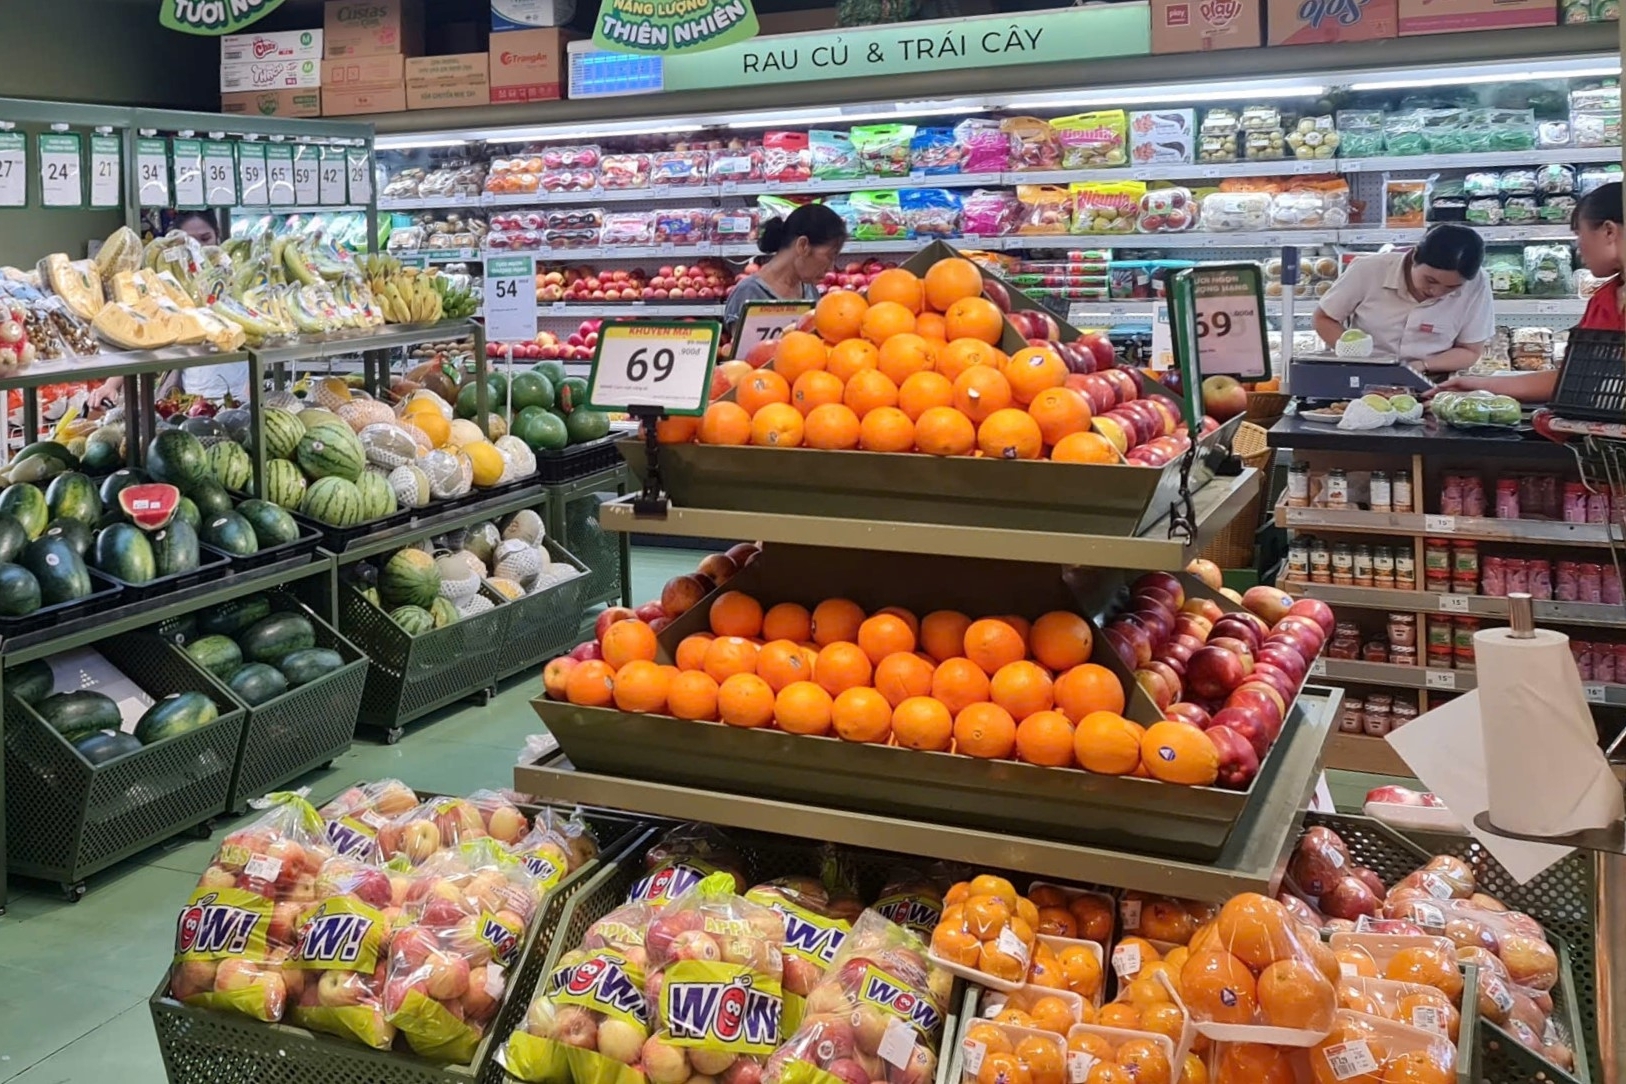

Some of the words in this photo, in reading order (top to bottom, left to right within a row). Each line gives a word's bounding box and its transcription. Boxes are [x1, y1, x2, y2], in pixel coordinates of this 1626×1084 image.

[603, 16, 667, 45] THIÊN
[674, 0, 746, 43] NHIÊN
[743, 49, 798, 73] RAU
[811, 36, 848, 67] CỦ
[866, 42, 884, 63] &
[898, 30, 966, 61] TRÁI
[981, 24, 1043, 54] CÂY
[0, 160, 13, 178] 7
[48, 163, 68, 180] 24
[99, 161, 112, 177] 21
[142, 164, 159, 180] 34
[210, 165, 226, 181] 36
[245, 166, 259, 181] 59
[296, 168, 309, 183] 59
[323, 168, 337, 183] 42
[352, 167, 364, 182] 29
[496, 280, 517, 298] 54
[626, 348, 675, 382] 69
[178, 903, 262, 955] OW!
[782, 912, 846, 963] W!
[668, 982, 783, 1046] WOW
